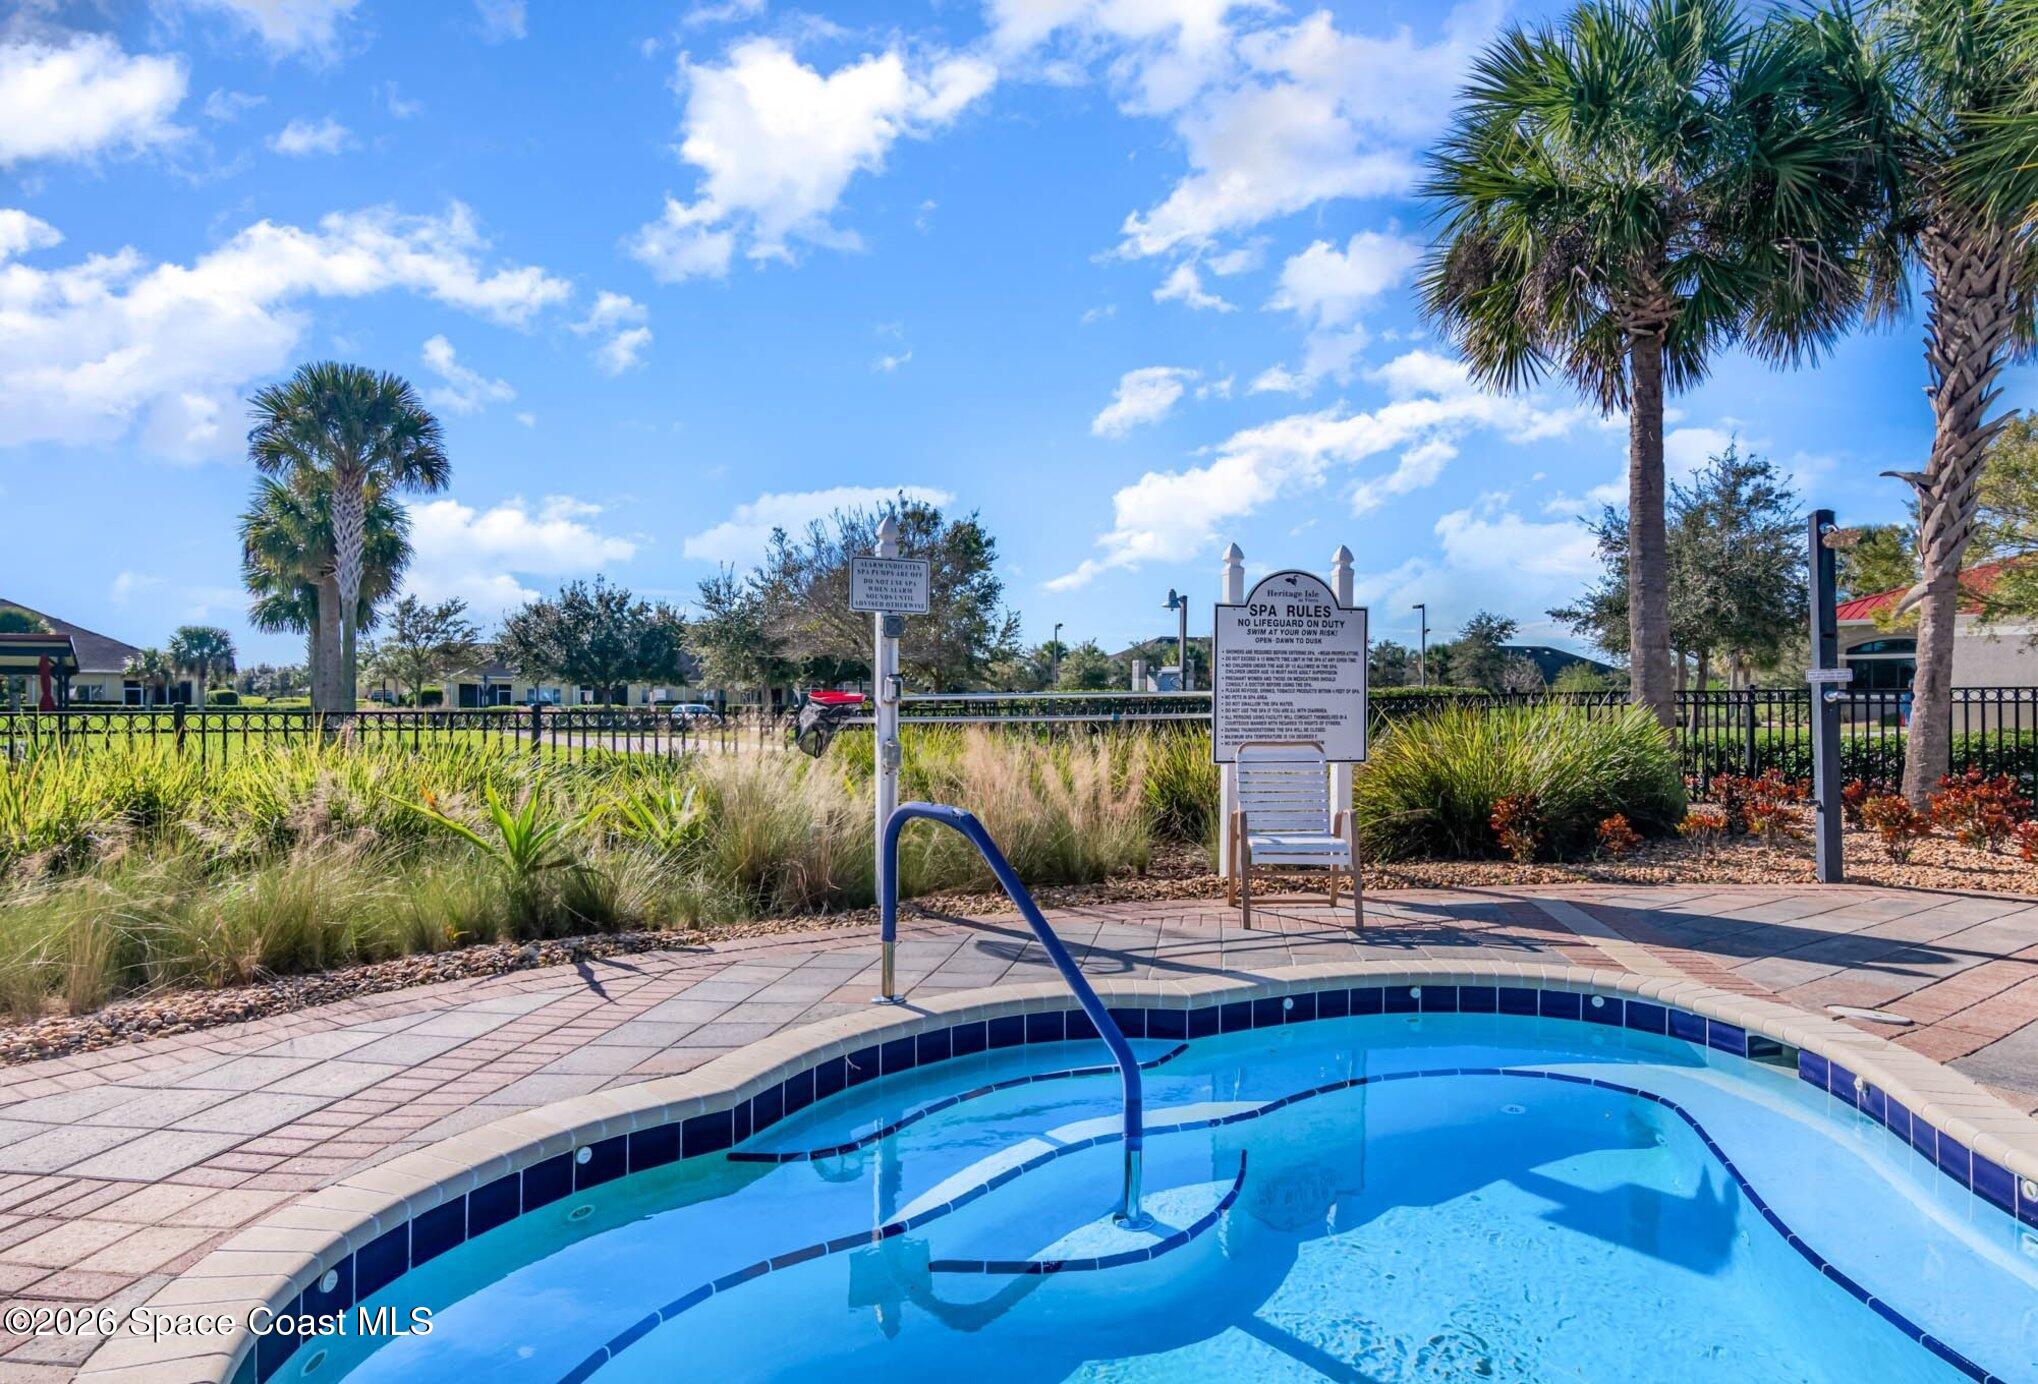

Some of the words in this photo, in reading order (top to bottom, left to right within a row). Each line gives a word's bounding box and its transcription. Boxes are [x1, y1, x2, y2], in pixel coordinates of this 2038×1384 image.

[1267, 590, 1302, 598] Heritage
[1250, 604, 1277, 617] SPA
[1287, 605, 1331, 618] RULES
[1254, 619, 1303, 627] LIFEGUARD
